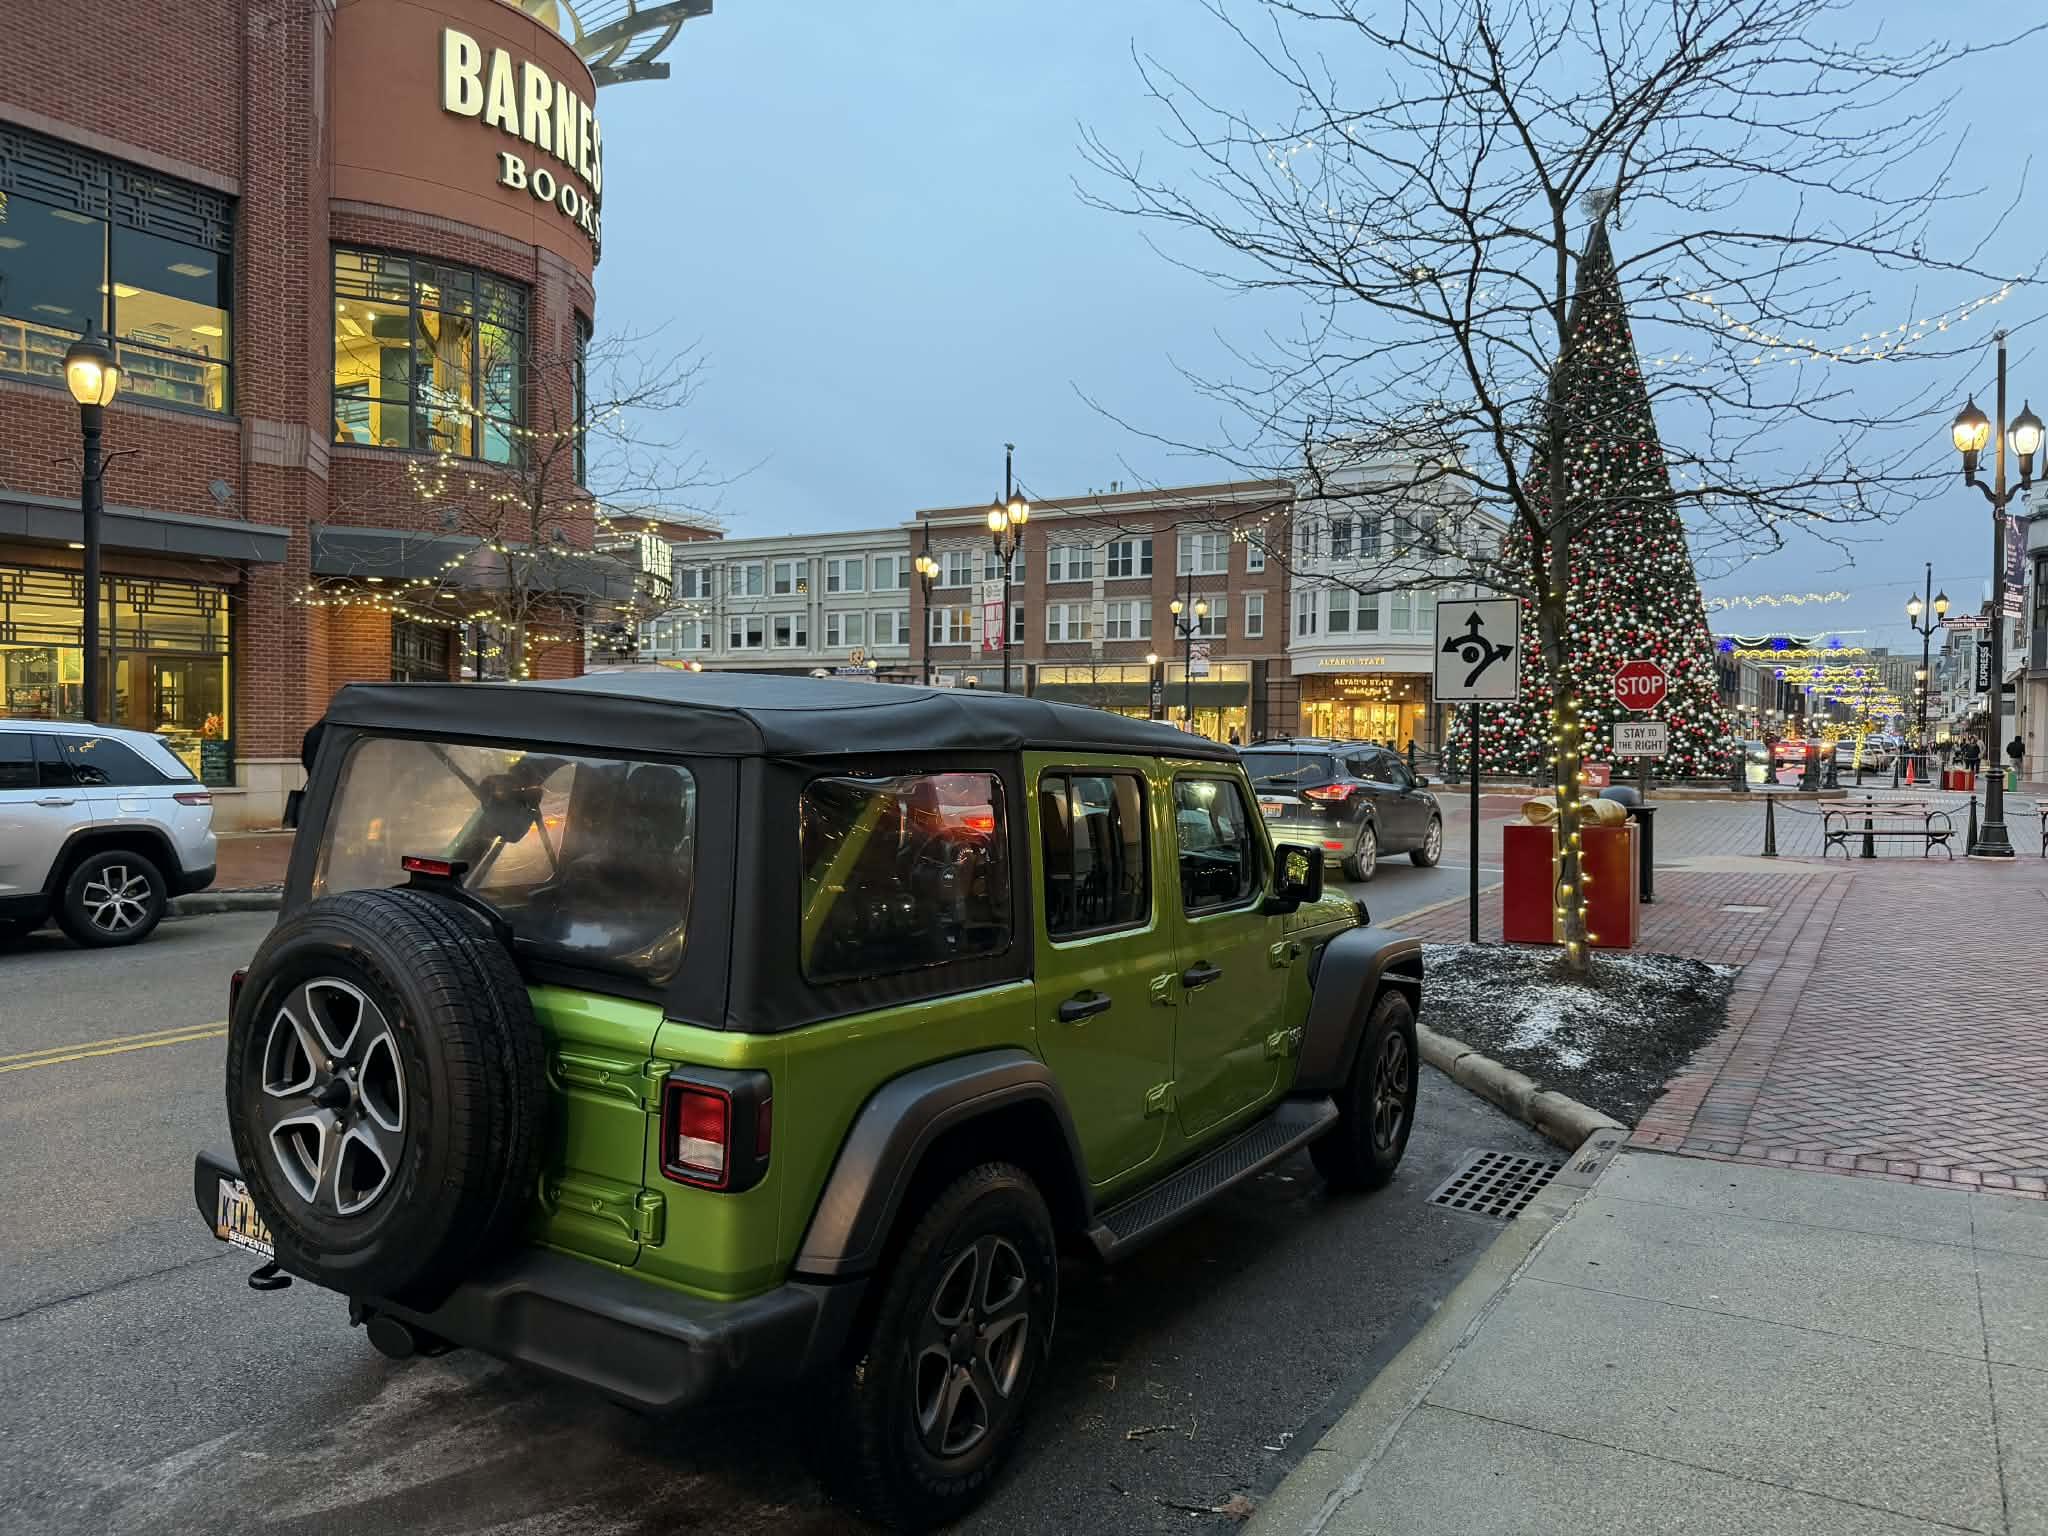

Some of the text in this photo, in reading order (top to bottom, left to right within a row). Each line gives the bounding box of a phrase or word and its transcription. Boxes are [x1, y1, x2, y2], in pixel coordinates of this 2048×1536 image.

[444, 27, 602, 195] BARNES
[500, 151, 601, 243] BOOKS
[1979, 646, 1989, 687] EXPRESS
[1617, 676, 1663, 696] STOP
[1616, 740, 1664, 751] THE RIGHT
[1623, 728, 1657, 739] STAY TO
